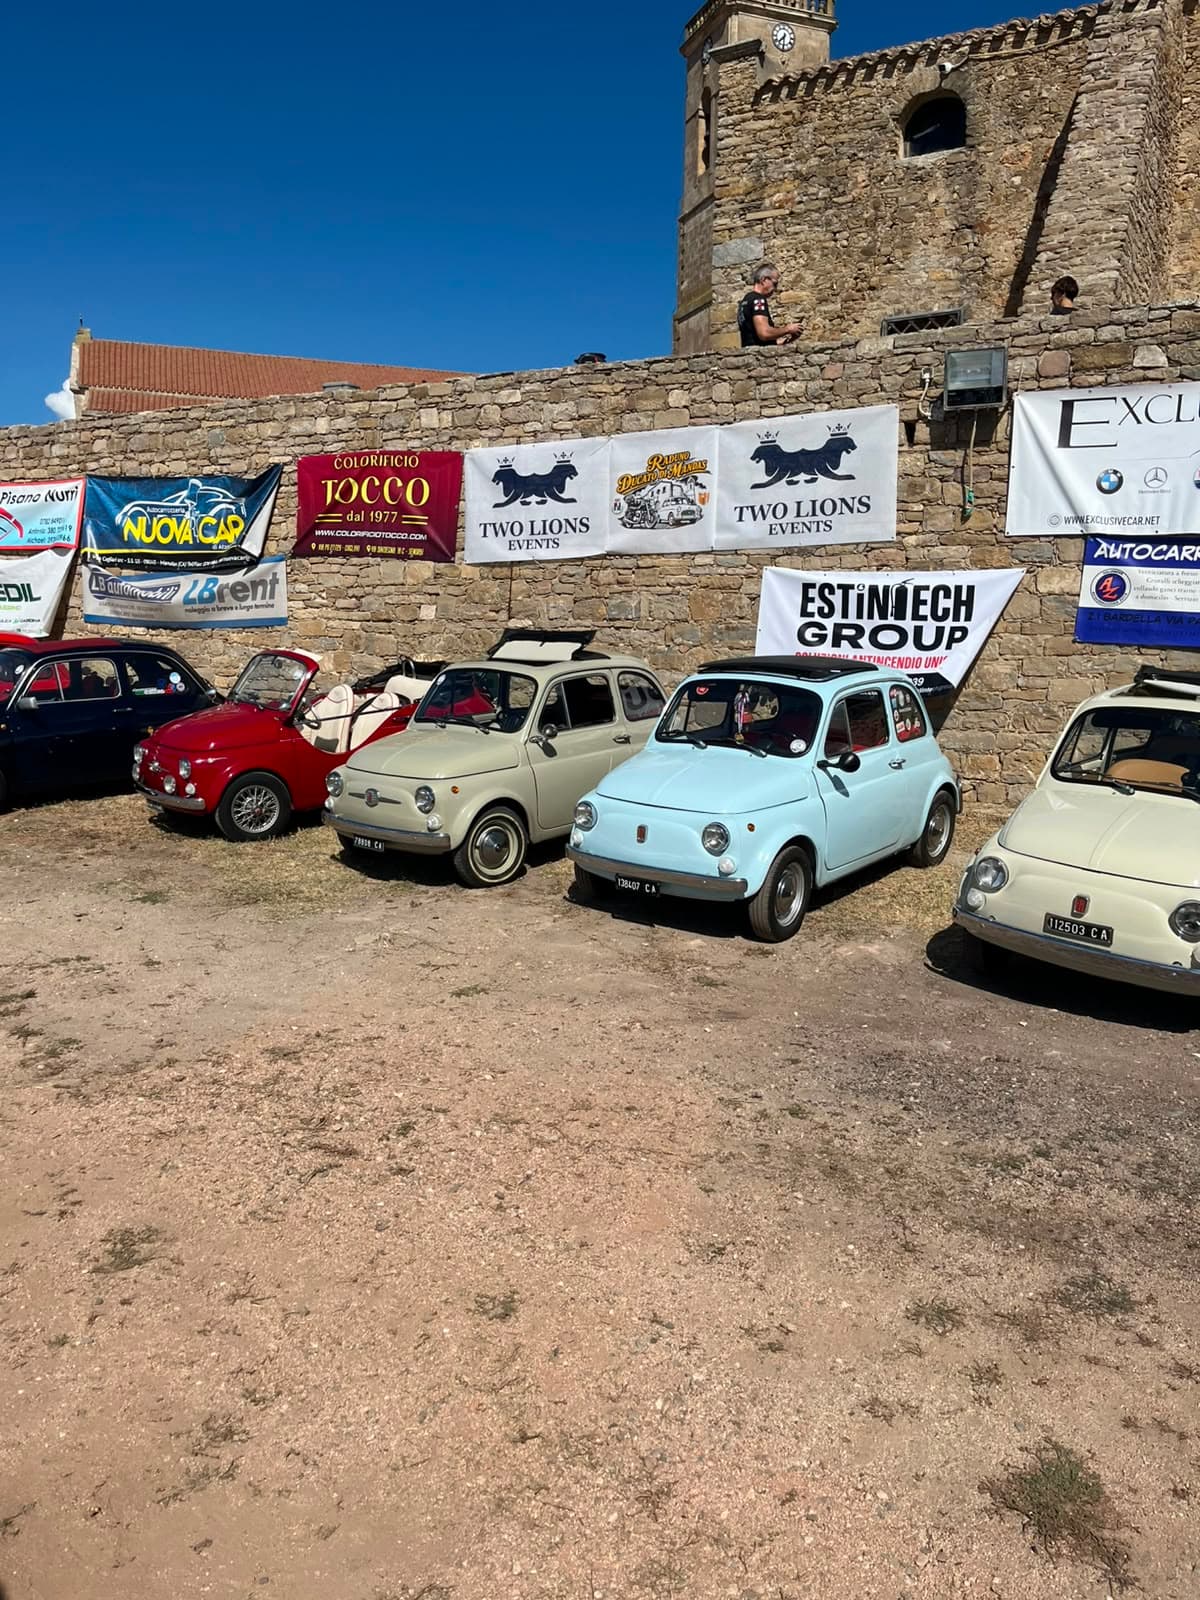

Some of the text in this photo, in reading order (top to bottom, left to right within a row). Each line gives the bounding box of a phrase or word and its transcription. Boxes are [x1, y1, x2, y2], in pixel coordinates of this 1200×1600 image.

[1058, 393, 1200, 449] EXCL
[334, 455, 419, 470] COLORIFICIO
[668, 459, 708, 479] MANDAS
[0, 486, 78, 505] Pisano Nurri
[322, 475, 430, 507] TOCCO
[346, 511, 398, 523] dal 1977
[734, 495, 871, 522] TWO LIONS
[480, 516, 590, 538] TWO LIONS
[769, 520, 832, 536] EVENTS
[1064, 514, 1160, 526] WWW.EXCLUSIVECAR.NET
[123, 515, 245, 545] NUOVA CAR
[315, 529, 428, 541] WWW.COLORIFICIOTOCCO.COM
[508, 538, 560, 551] EVENTS
[91, 575, 178, 600] LB automobili
[797, 621, 969, 651] GROUP
[617, 878, 657, 894] 138407 CA
[1050, 917, 1086, 936] 112503
